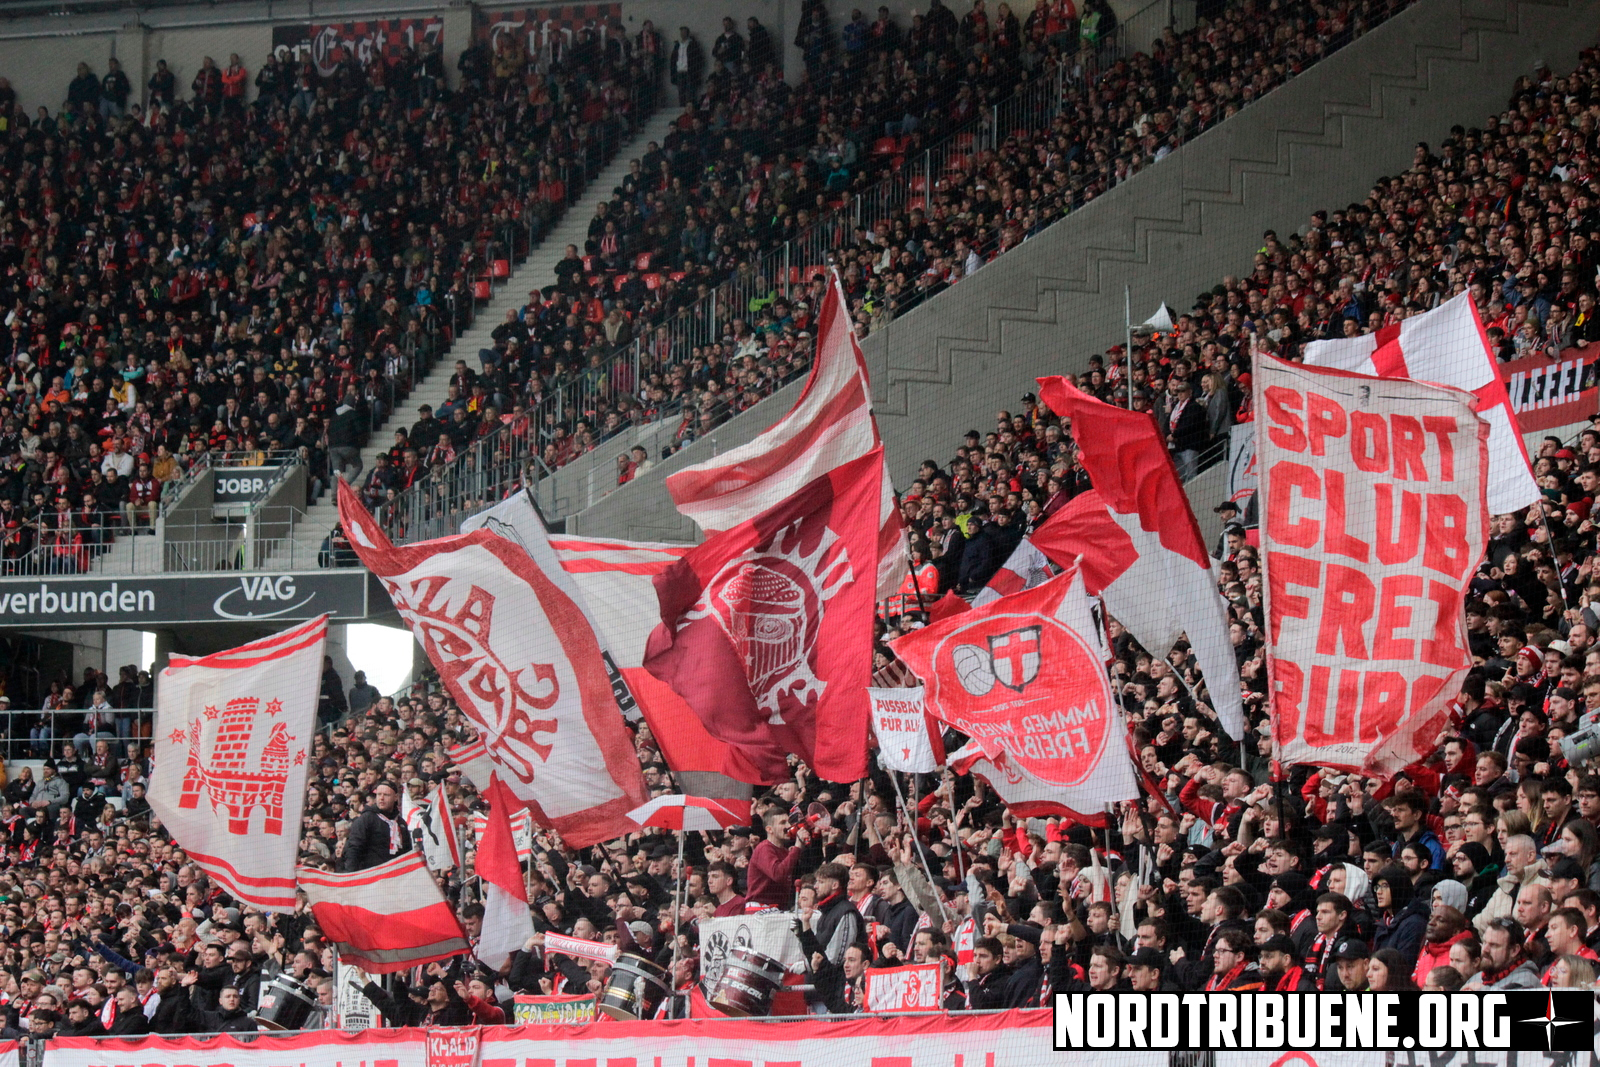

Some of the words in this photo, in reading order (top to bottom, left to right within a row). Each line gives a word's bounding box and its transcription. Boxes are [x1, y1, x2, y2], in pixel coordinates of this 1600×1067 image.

[1264, 384, 1458, 482] SPORT
[1267, 460, 1469, 580] CLUB
[240, 575, 296, 601] VAG
[1267, 551, 1468, 669] FREI
[881, 715, 902, 731] FÜR
[430, 1036, 477, 1057] KHALID
